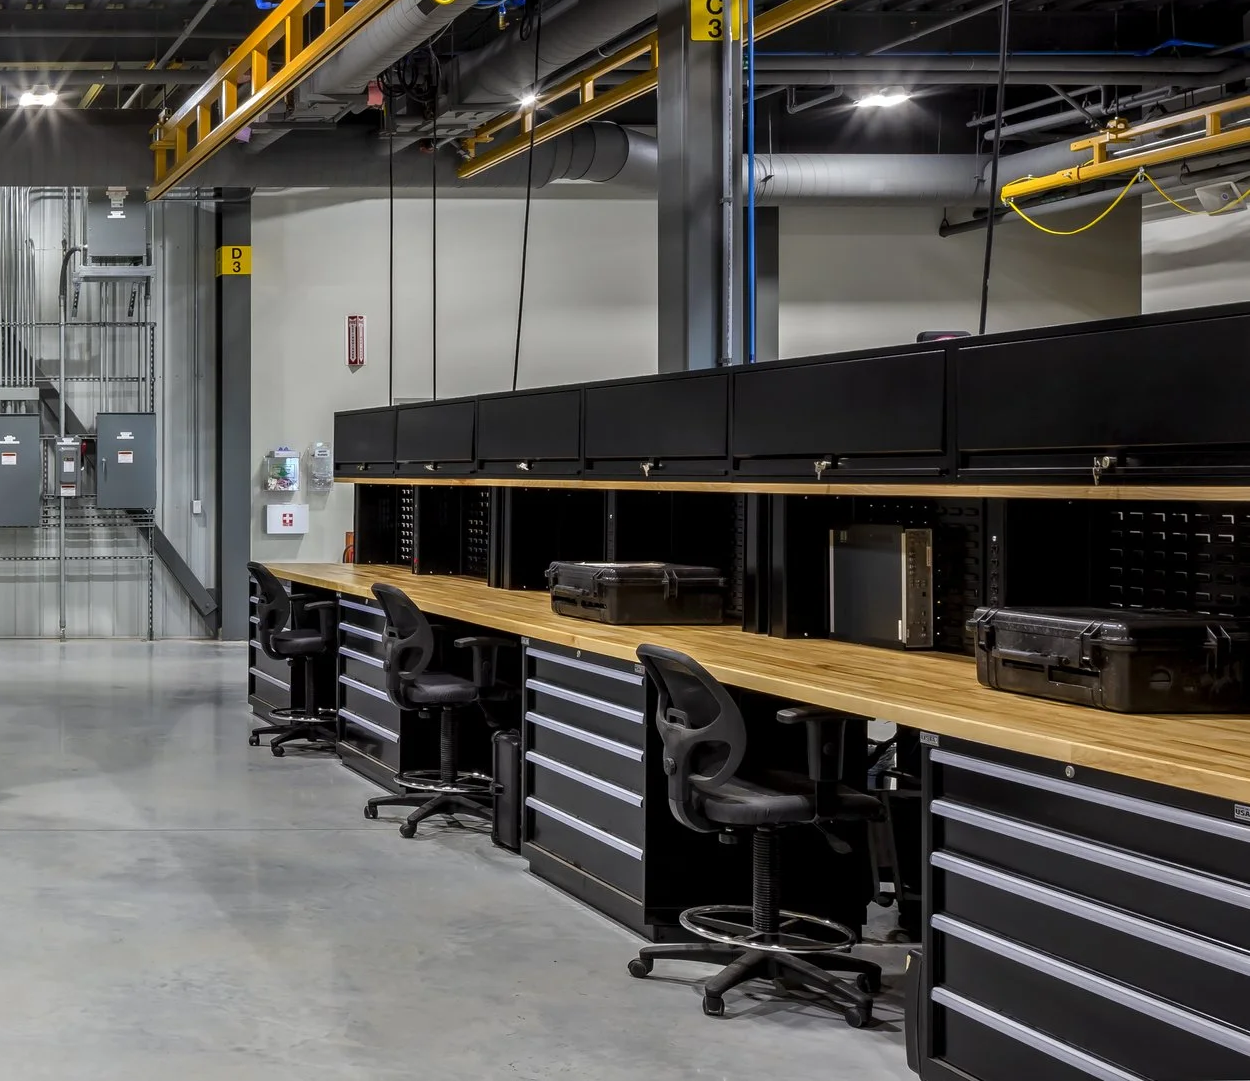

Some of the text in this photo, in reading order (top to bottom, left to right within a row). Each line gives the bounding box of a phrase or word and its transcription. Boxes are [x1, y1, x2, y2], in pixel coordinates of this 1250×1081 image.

[707, 18, 723, 38] 3
[231, 247, 243, 260] D
[232, 261, 241, 273] 3
